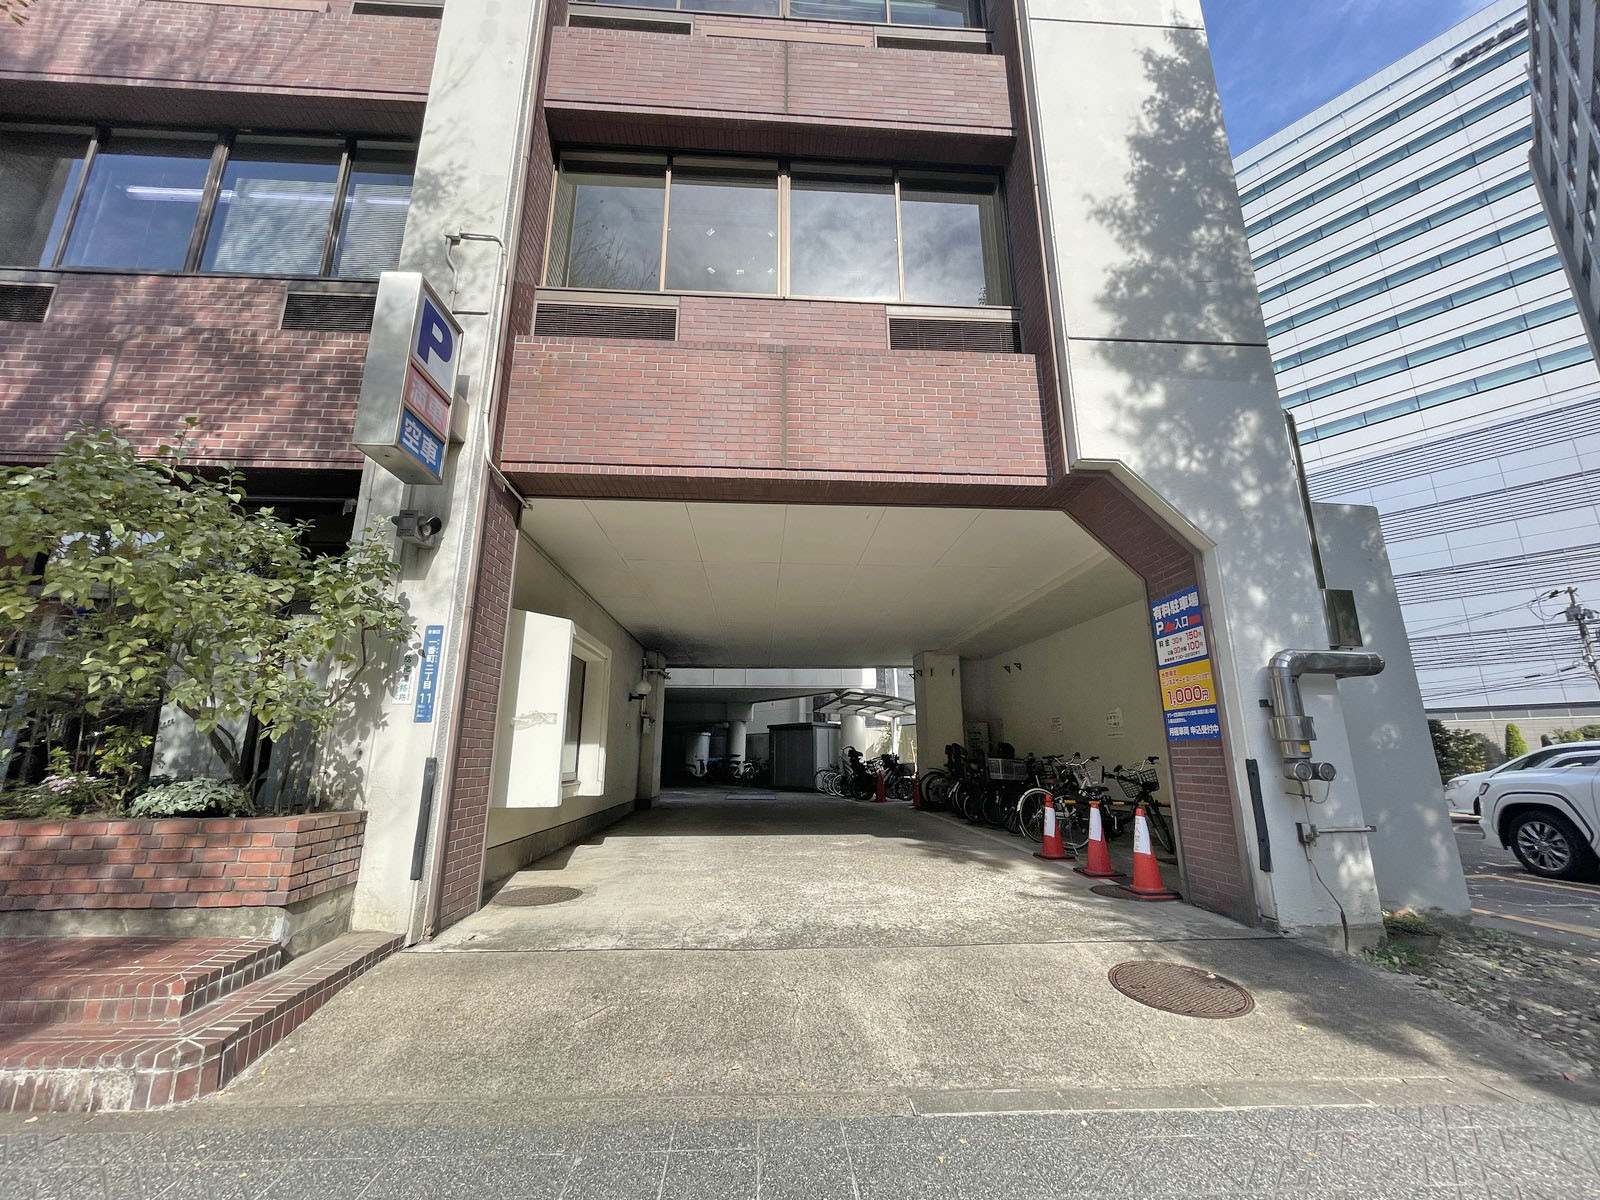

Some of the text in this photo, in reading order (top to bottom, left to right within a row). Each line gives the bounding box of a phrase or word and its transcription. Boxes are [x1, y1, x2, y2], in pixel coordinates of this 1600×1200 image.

[417, 296, 454, 364] P
[409, 374, 444, 426] 満車
[402, 416, 439, 467] 空車
[1152, 591, 1199, 621] 有料駐車場
[1155, 615, 1189, 636] P 入口
[423, 639, 438, 690] 一番町二丁目
[420, 692, 432, 705] 11
[1167, 685, 1210, 707] 1,000円
